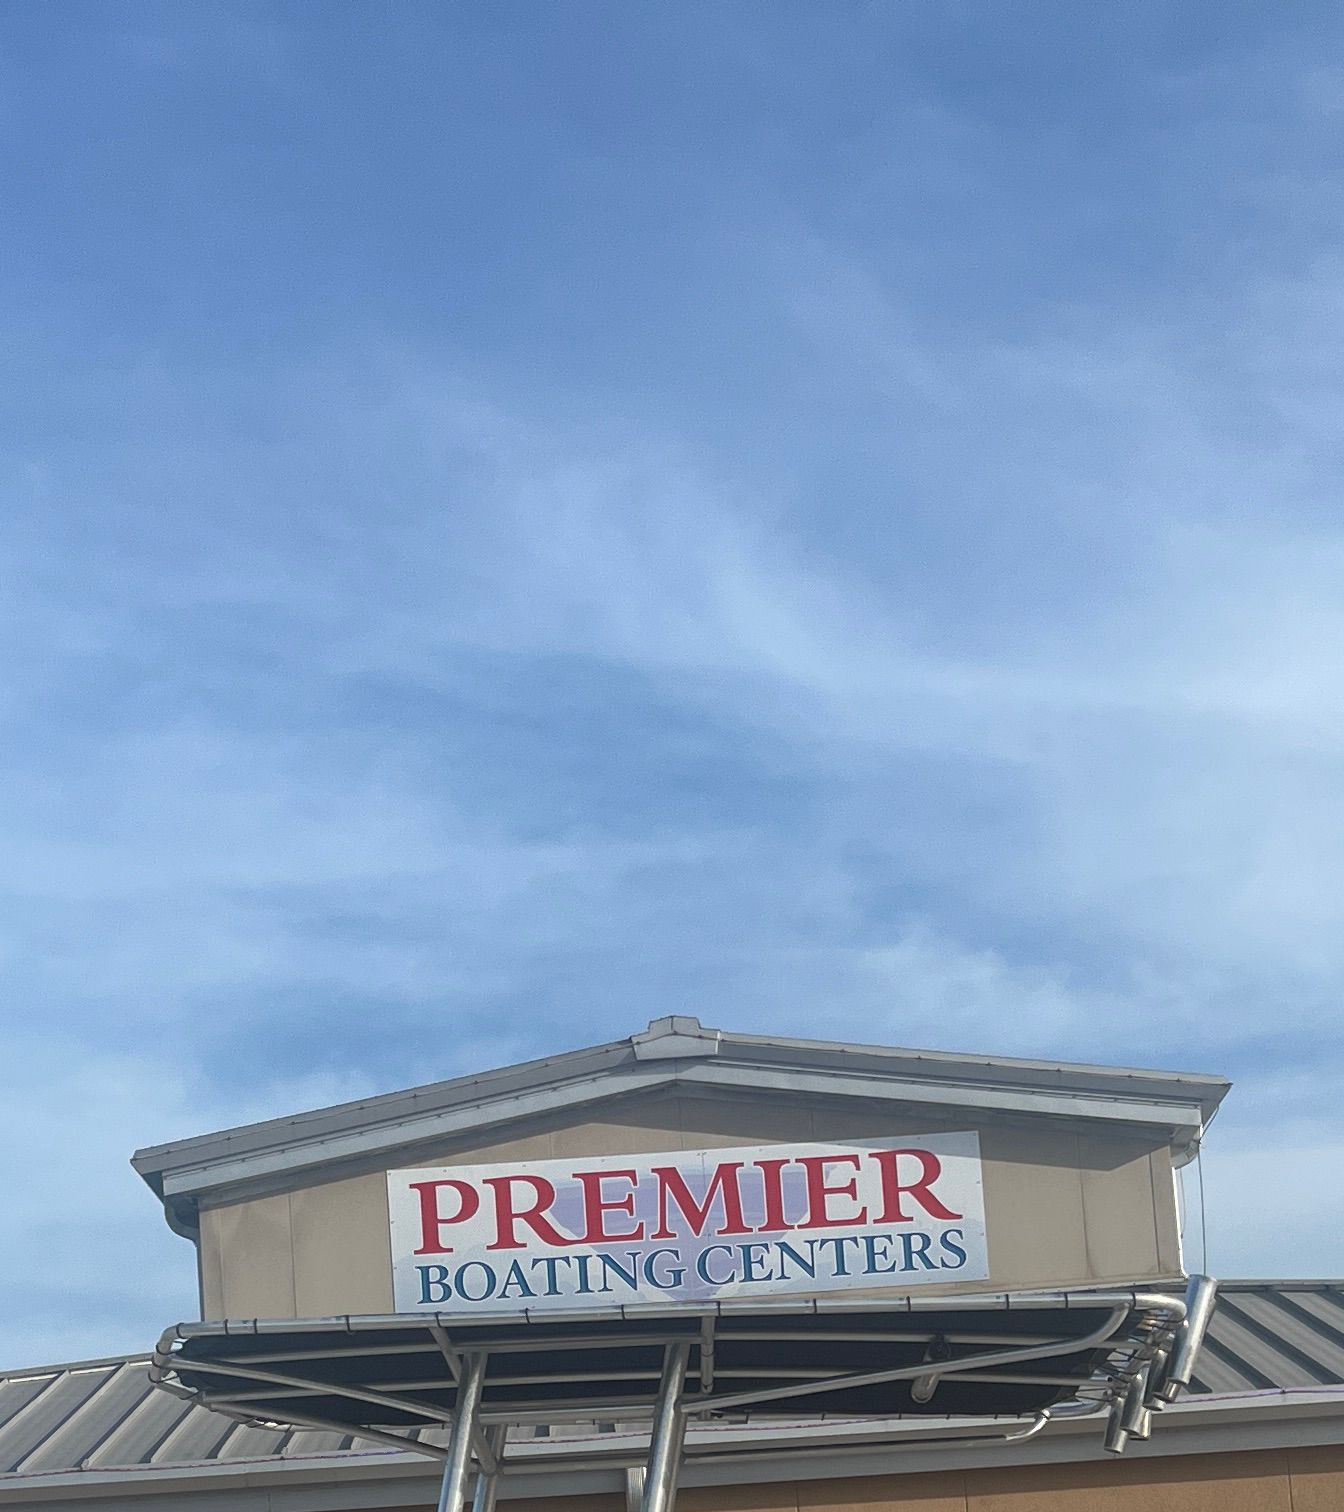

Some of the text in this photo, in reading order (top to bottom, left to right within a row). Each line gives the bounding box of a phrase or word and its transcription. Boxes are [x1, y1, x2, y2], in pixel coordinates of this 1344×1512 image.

[409, 1149, 963, 1256] PREMIER
[416, 1228, 968, 1305] BOATING CENTERS
